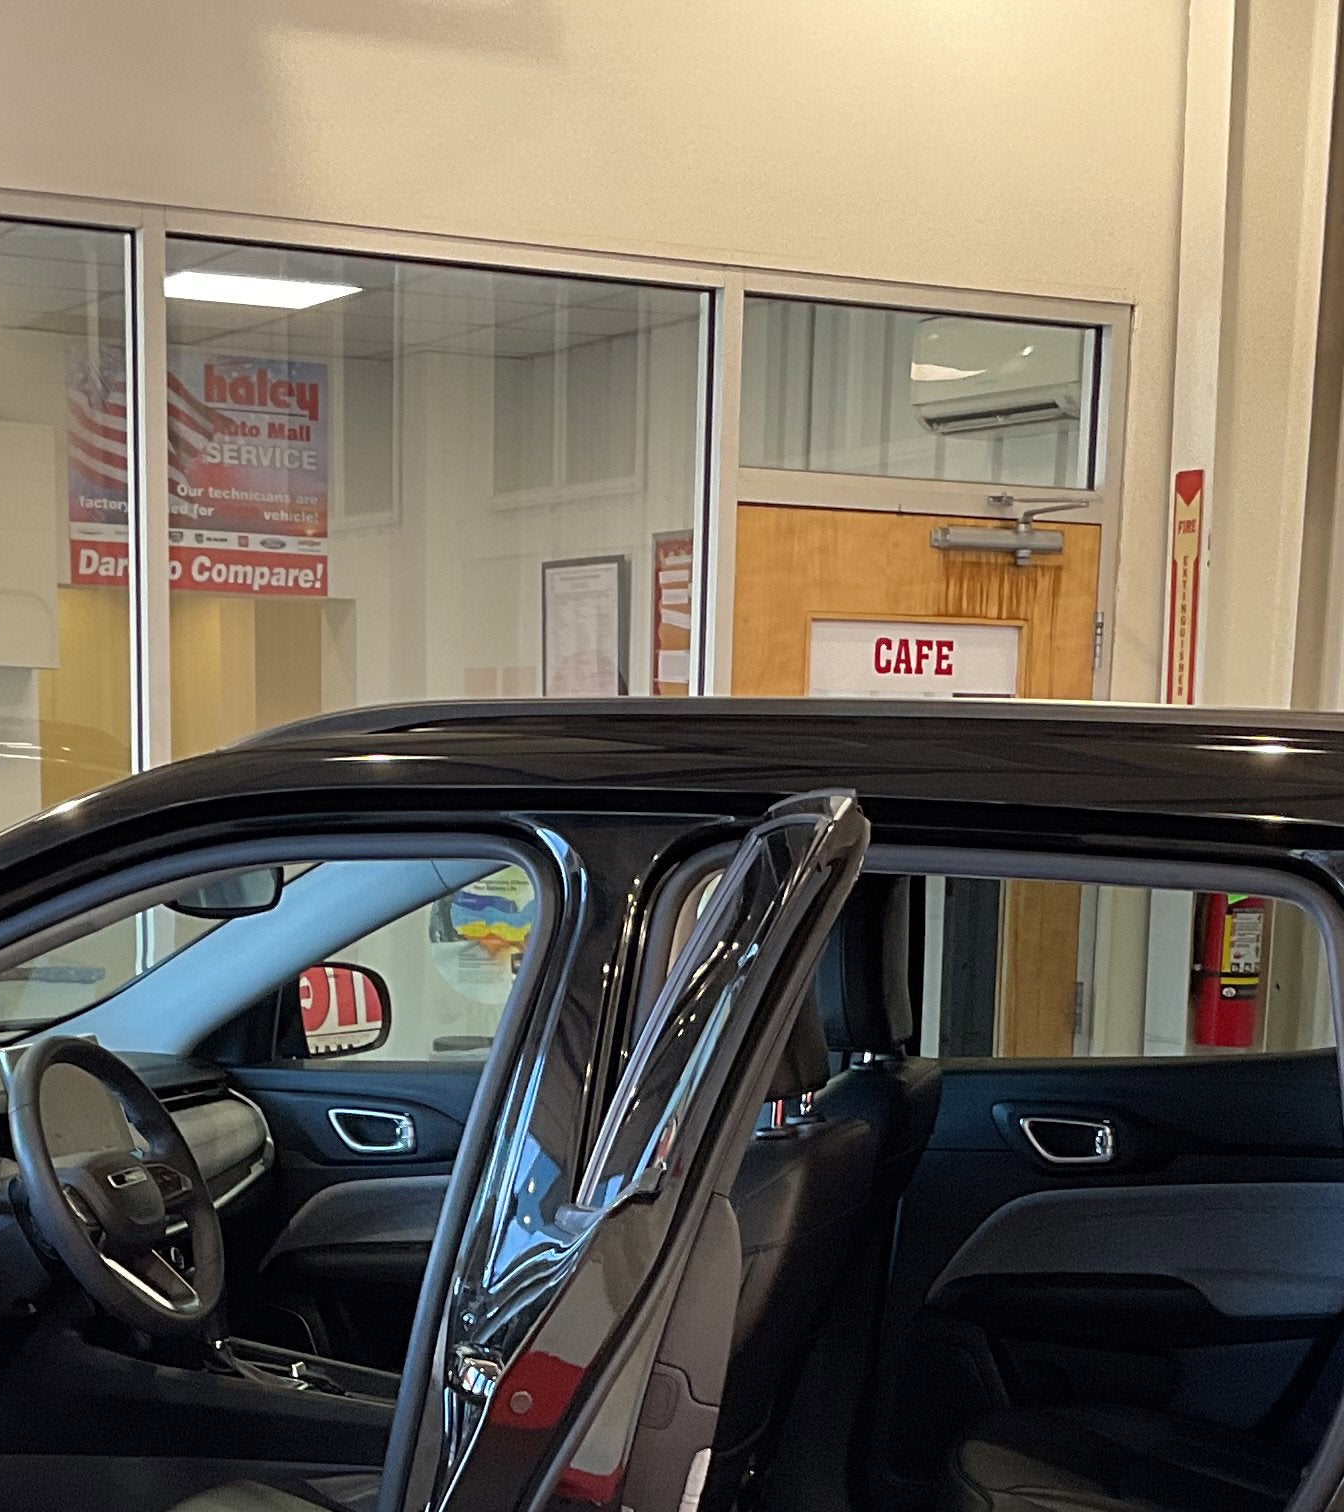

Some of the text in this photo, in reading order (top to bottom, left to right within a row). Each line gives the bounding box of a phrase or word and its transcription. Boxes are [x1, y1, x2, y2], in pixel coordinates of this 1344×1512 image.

[203, 364, 320, 421] haley
[213, 421, 311, 441] Auto Mall
[206, 441, 318, 470] SERVICE
[177, 484, 318, 506] Our technicians are
[264, 510, 319, 524] vehicle!
[1177, 519, 1197, 535] FIRE
[78, 548, 128, 577] Dar
[191, 556, 324, 590] Compare!
[1177, 555, 1190, 697] EXTINGUISHER
[873, 637, 955, 677] CAFE
